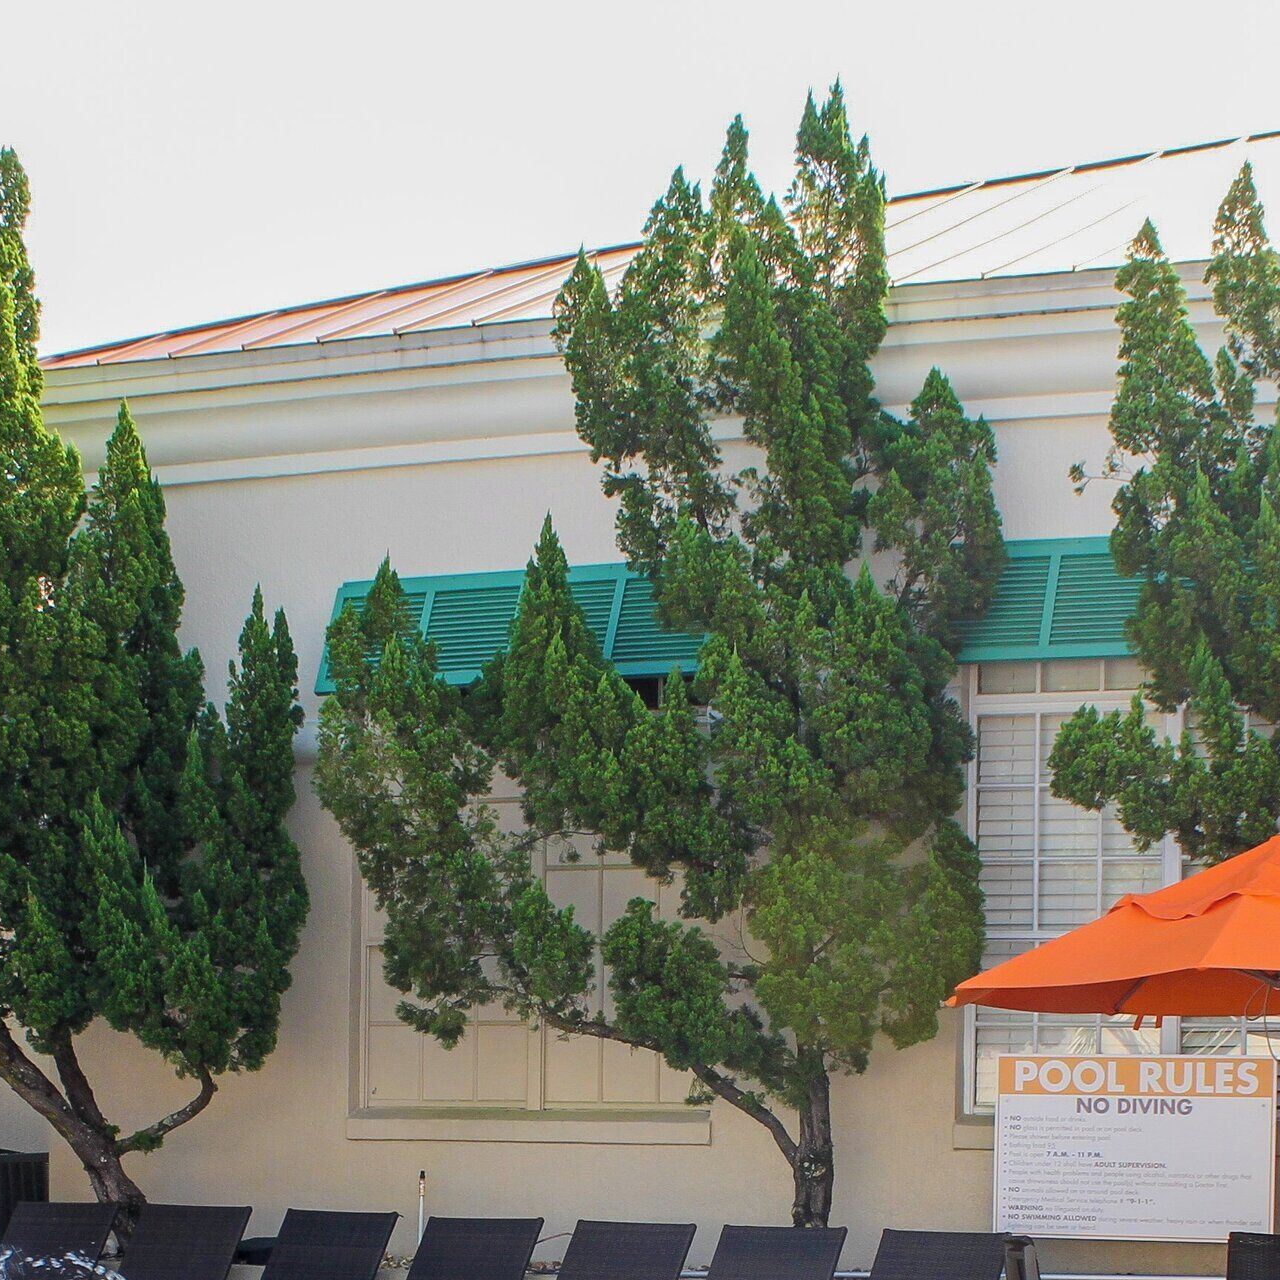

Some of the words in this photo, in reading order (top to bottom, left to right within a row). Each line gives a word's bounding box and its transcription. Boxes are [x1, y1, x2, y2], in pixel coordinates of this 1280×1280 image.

[1014, 1059, 1124, 1094] POOL
[1139, 1061, 1259, 1095] RULES
[1076, 1097, 1110, 1115] NO
[1117, 1098, 1194, 1116] DIVING
